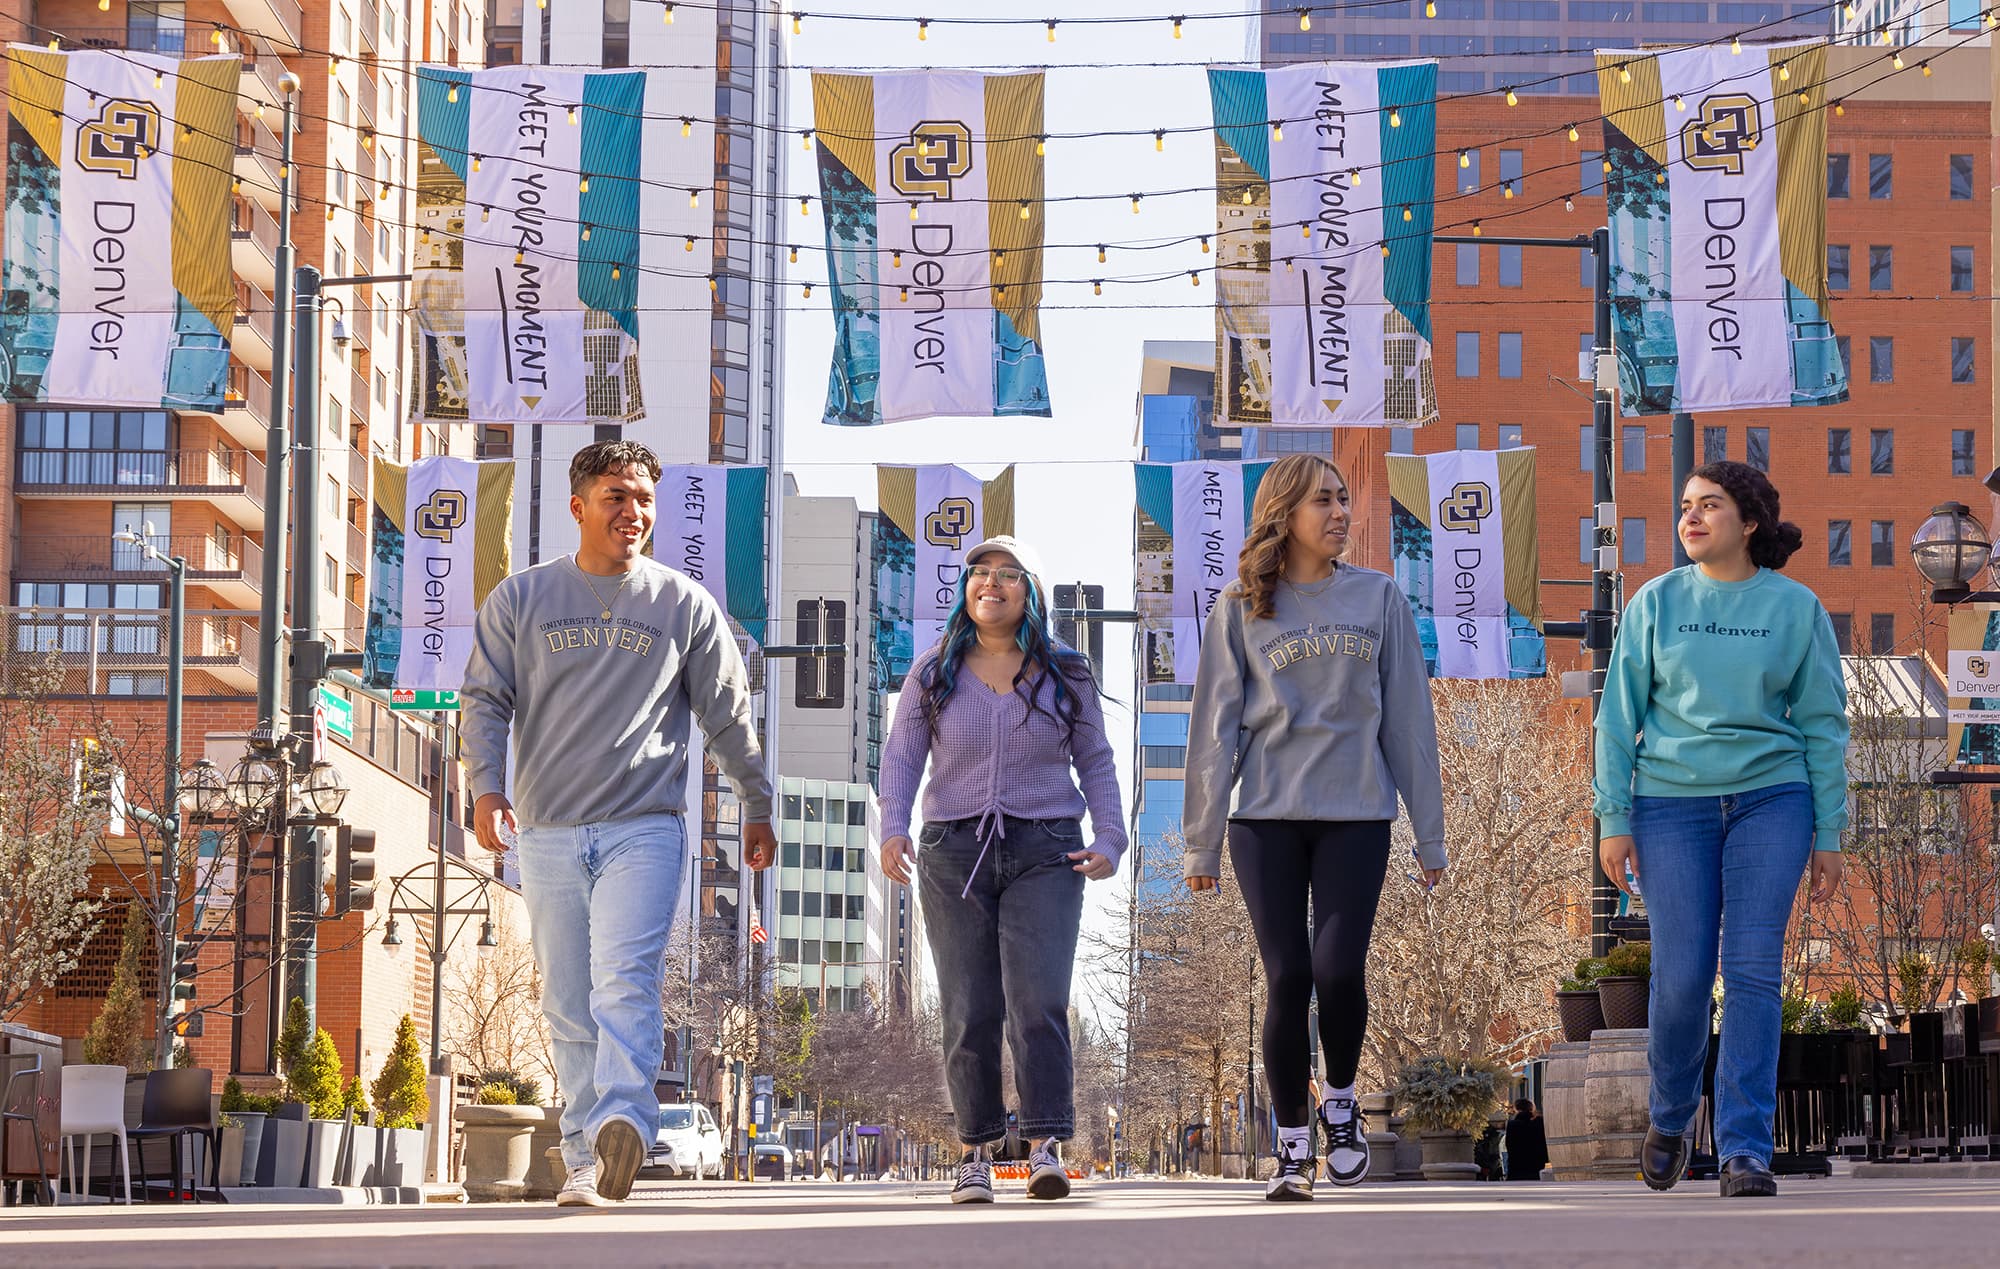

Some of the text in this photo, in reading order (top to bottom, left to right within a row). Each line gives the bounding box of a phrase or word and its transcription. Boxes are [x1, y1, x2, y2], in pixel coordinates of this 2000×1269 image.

[512, 83, 548, 390] MEET YOUR MOMENT
[1313, 81, 1350, 393] MEET YOUR MOMENT
[89, 200, 135, 360] Denver
[911, 224, 953, 374] Denver
[1704, 197, 1747, 361] Denver
[1202, 471, 1222, 520] MEET
[681, 475, 705, 581] MEET YOUR
[1201, 530, 1225, 578] YOUR
[423, 557, 451, 662] Denver
[1454, 548, 1481, 649] Denver
[539, 616, 663, 638] UNIVERSITY OF COLORADO
[544, 626, 654, 657] DENVER
[1259, 624, 1381, 654] UNIVERSIT OF COLORADO
[1678, 622, 1771, 638] cu denver
[1267, 634, 1373, 672] DENVER
[392, 694, 414, 702] DENVER
[1956, 680, 2000, 692] Denver
